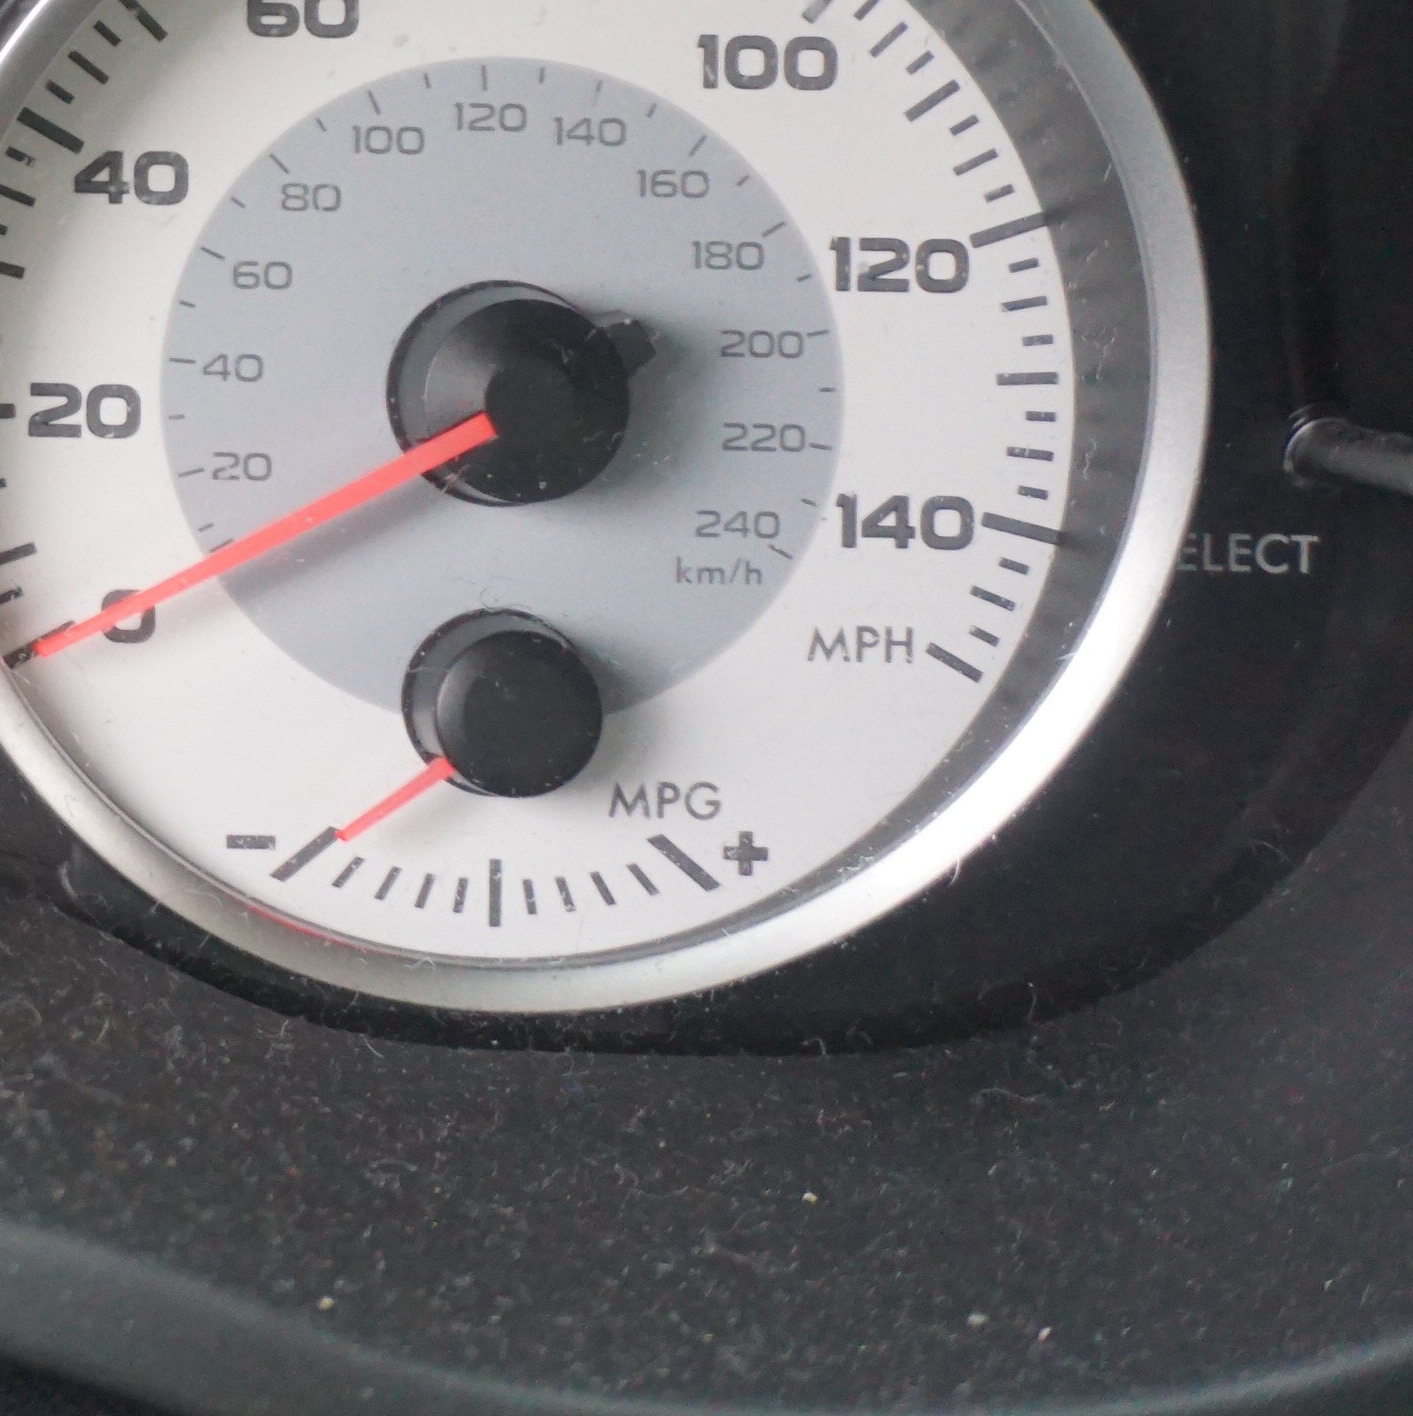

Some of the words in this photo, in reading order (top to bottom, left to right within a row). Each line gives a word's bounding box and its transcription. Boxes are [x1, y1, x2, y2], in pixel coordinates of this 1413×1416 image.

[696, 33, 839, 92] 100
[453, 101, 528, 134] 120
[553, 116, 627, 148] 140
[351, 124, 426, 156] 100
[73, 150, 190, 205] 40
[636, 168, 711, 200] 160
[280, 182, 342, 213] 80
[691, 240, 766, 272] 180
[831, 235, 970, 294] 120
[231, 260, 293, 291] 60
[720, 329, 805, 360] 200
[201, 353, 265, 384] 40
[26, 381, 141, 439] 20
[722, 423, 805, 453] 220
[211, 451, 273, 482] 20
[694, 508, 781, 540] 240
[835, 493, 976, 552] 140
[1174, 532, 1320, 574] ELECT
[675, 556, 763, 586] km/h
[100, 588, 156, 644] 0
[807, 625, 914, 665] MPH
[609, 780, 722, 821] MPG
